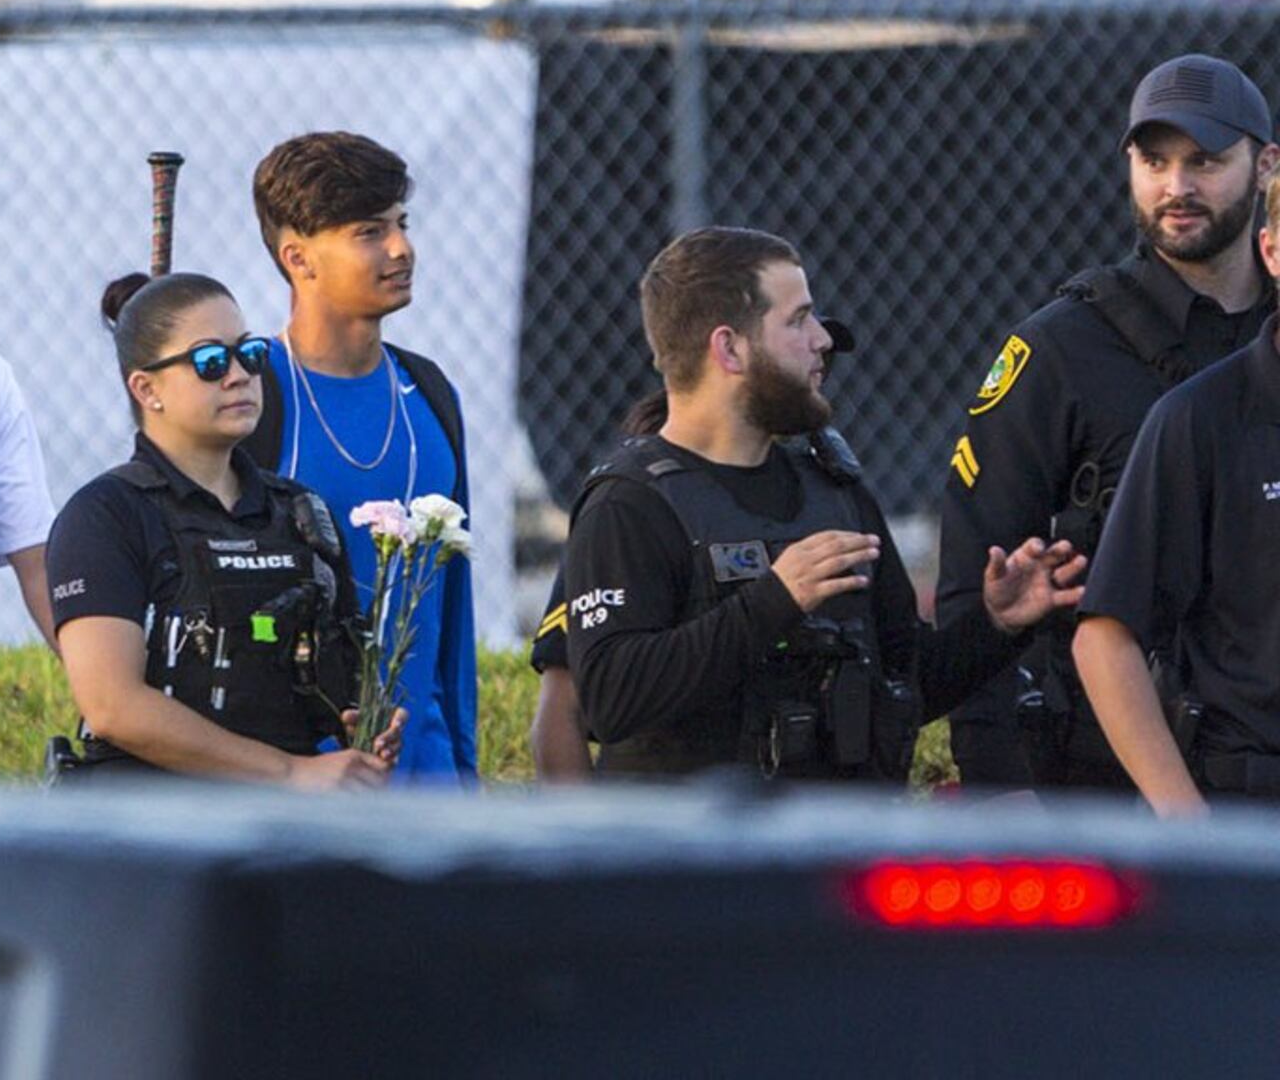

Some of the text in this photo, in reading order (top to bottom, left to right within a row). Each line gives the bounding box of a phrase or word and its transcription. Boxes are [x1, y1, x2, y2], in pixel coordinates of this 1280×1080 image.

[217, 554, 296, 569] POLICE
[53, 578, 86, 602] POLICE
[571, 588, 626, 617] POLICE
[582, 606, 608, 629] K-9
